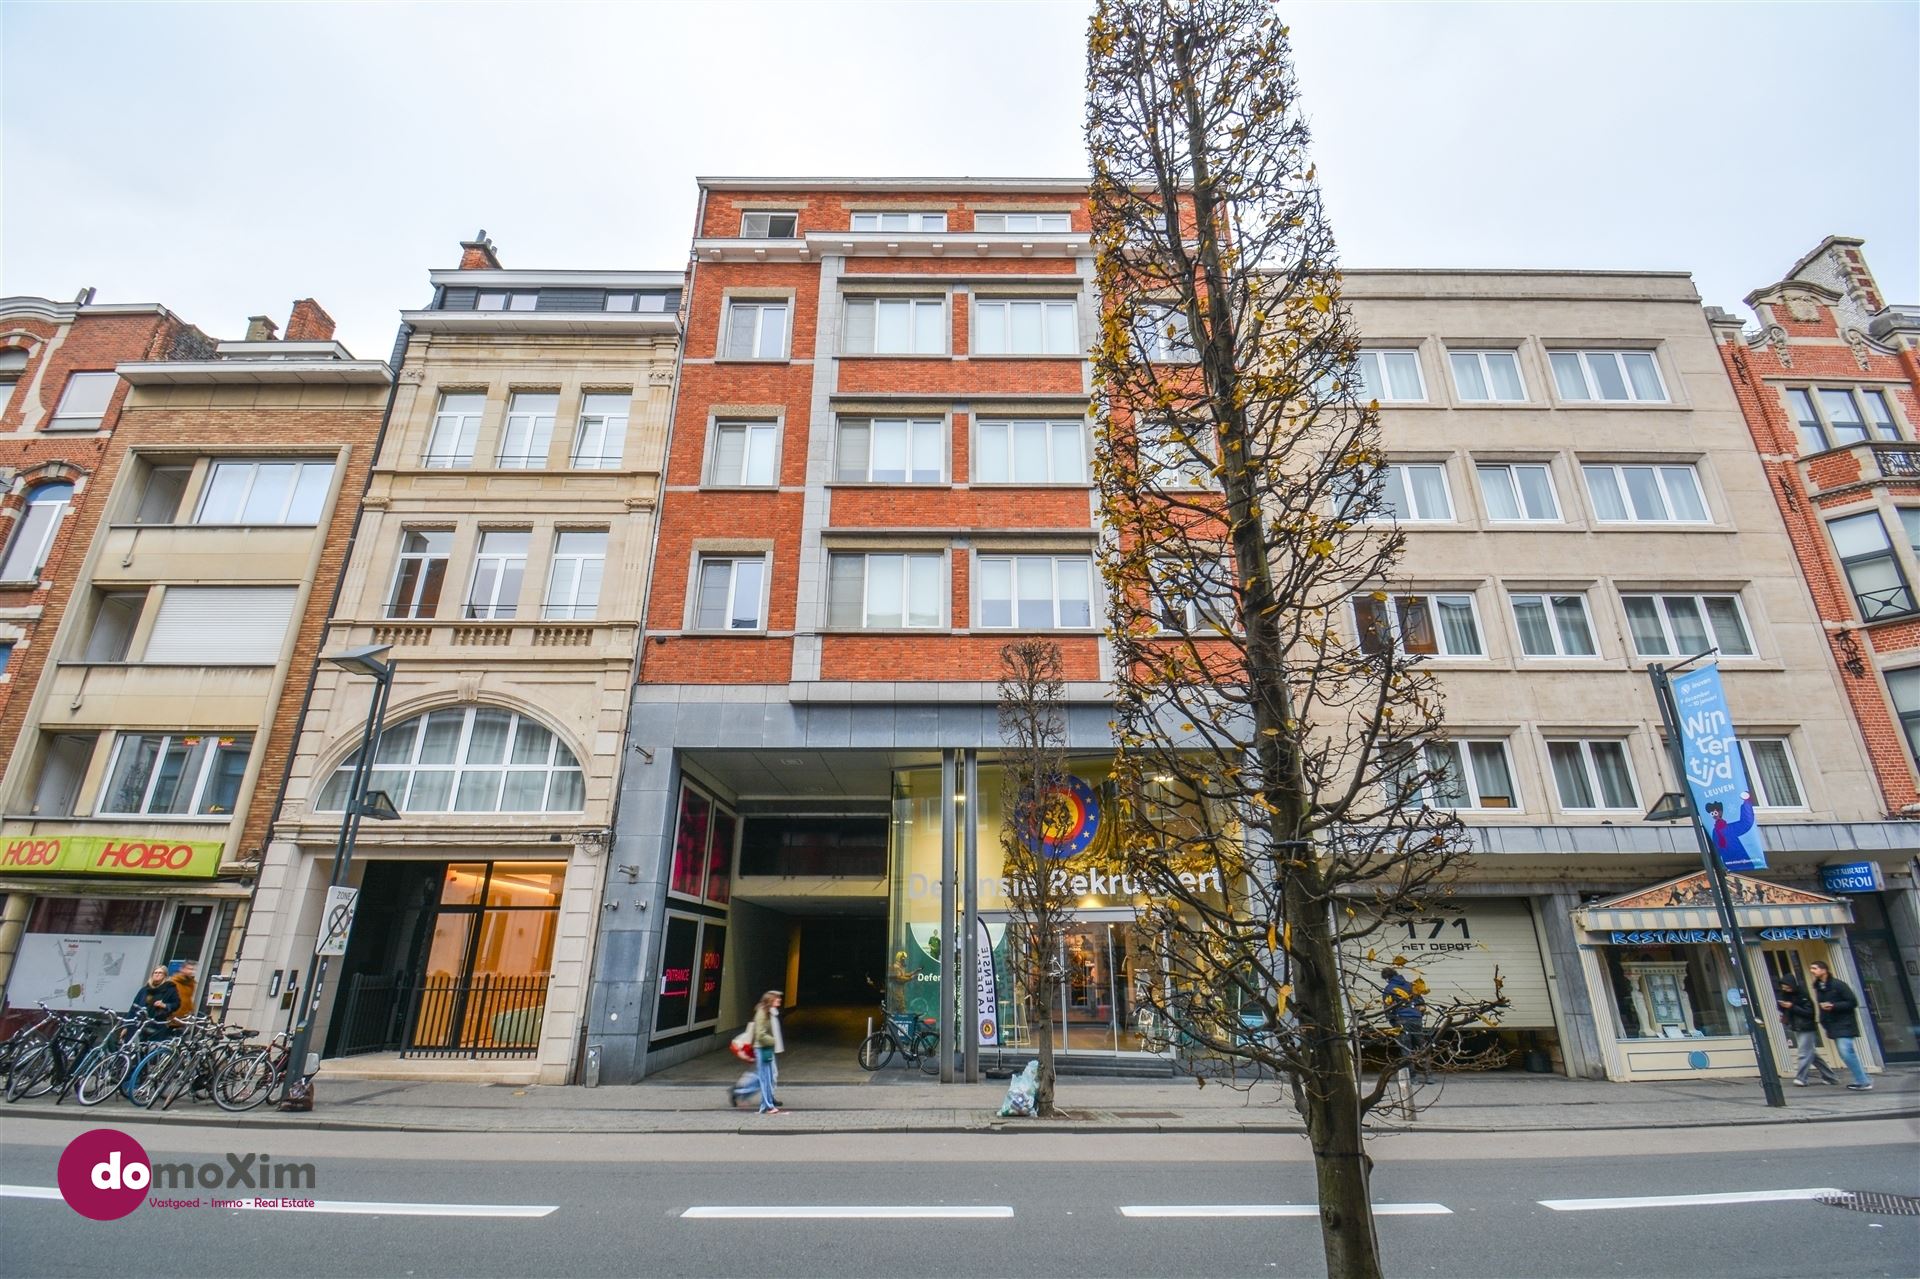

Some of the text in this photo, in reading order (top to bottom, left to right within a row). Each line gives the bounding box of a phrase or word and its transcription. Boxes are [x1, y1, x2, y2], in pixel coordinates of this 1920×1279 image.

[1681, 710, 1726, 740] Win
[1696, 735, 1736, 756] ter
[1687, 754, 1733, 787] tijd
[1704, 783, 1735, 798] LEUVEN
[1, 840, 61, 866] HOBO
[97, 842, 193, 869] HOBO
[1826, 876, 1872, 889] CORFOU
[336, 890, 353, 901] ZONE
[1399, 918, 1470, 939] 171
[1430, 943, 1472, 951] DEPOT
